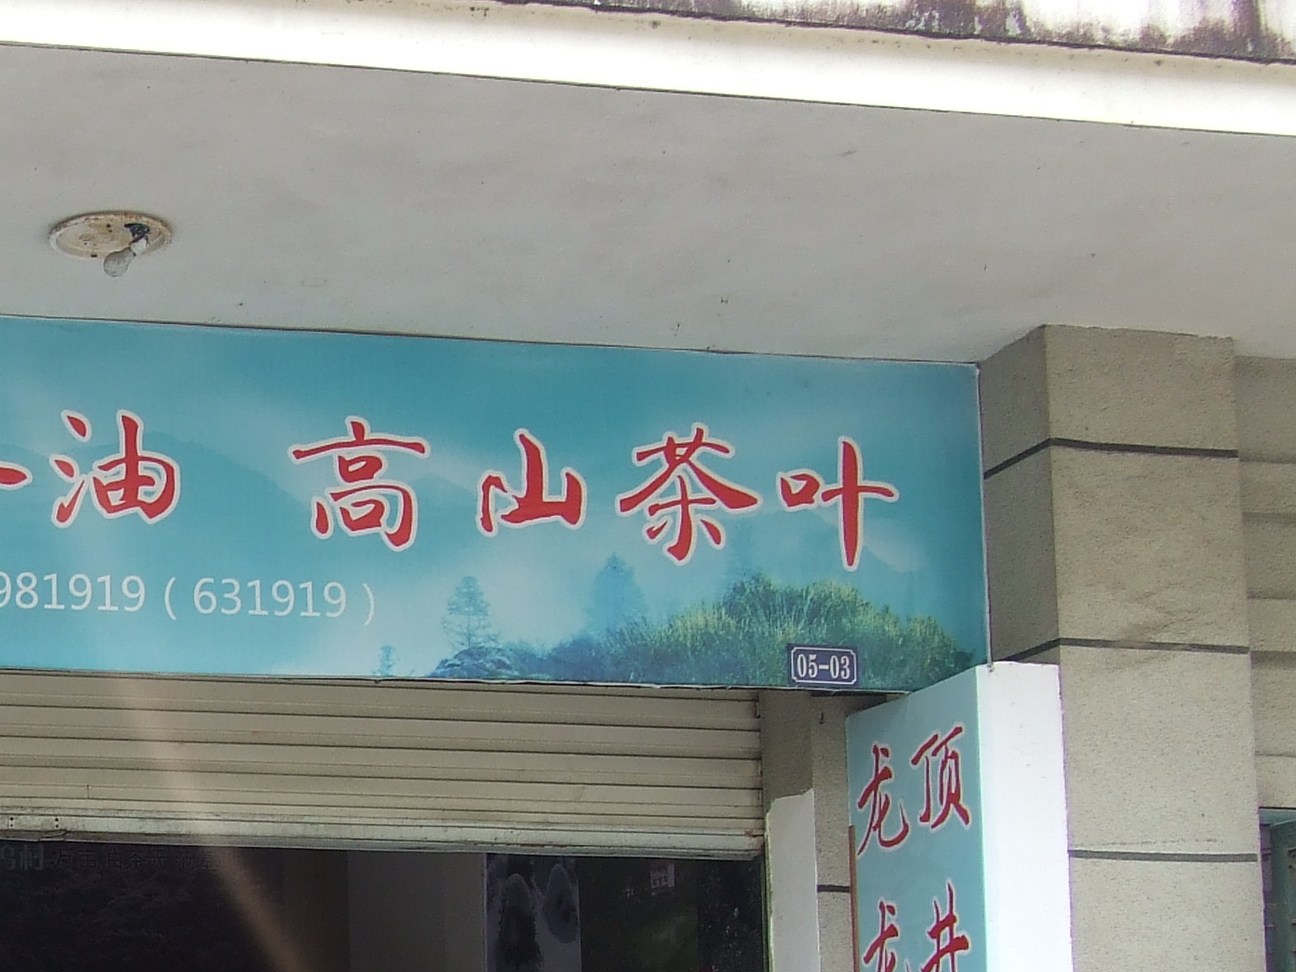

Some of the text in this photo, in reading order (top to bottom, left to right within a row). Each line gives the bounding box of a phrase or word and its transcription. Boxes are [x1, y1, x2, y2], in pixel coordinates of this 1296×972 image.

[289, 416, 899, 572] 高山茶叶
[796, 654, 852, 682] 05-03
